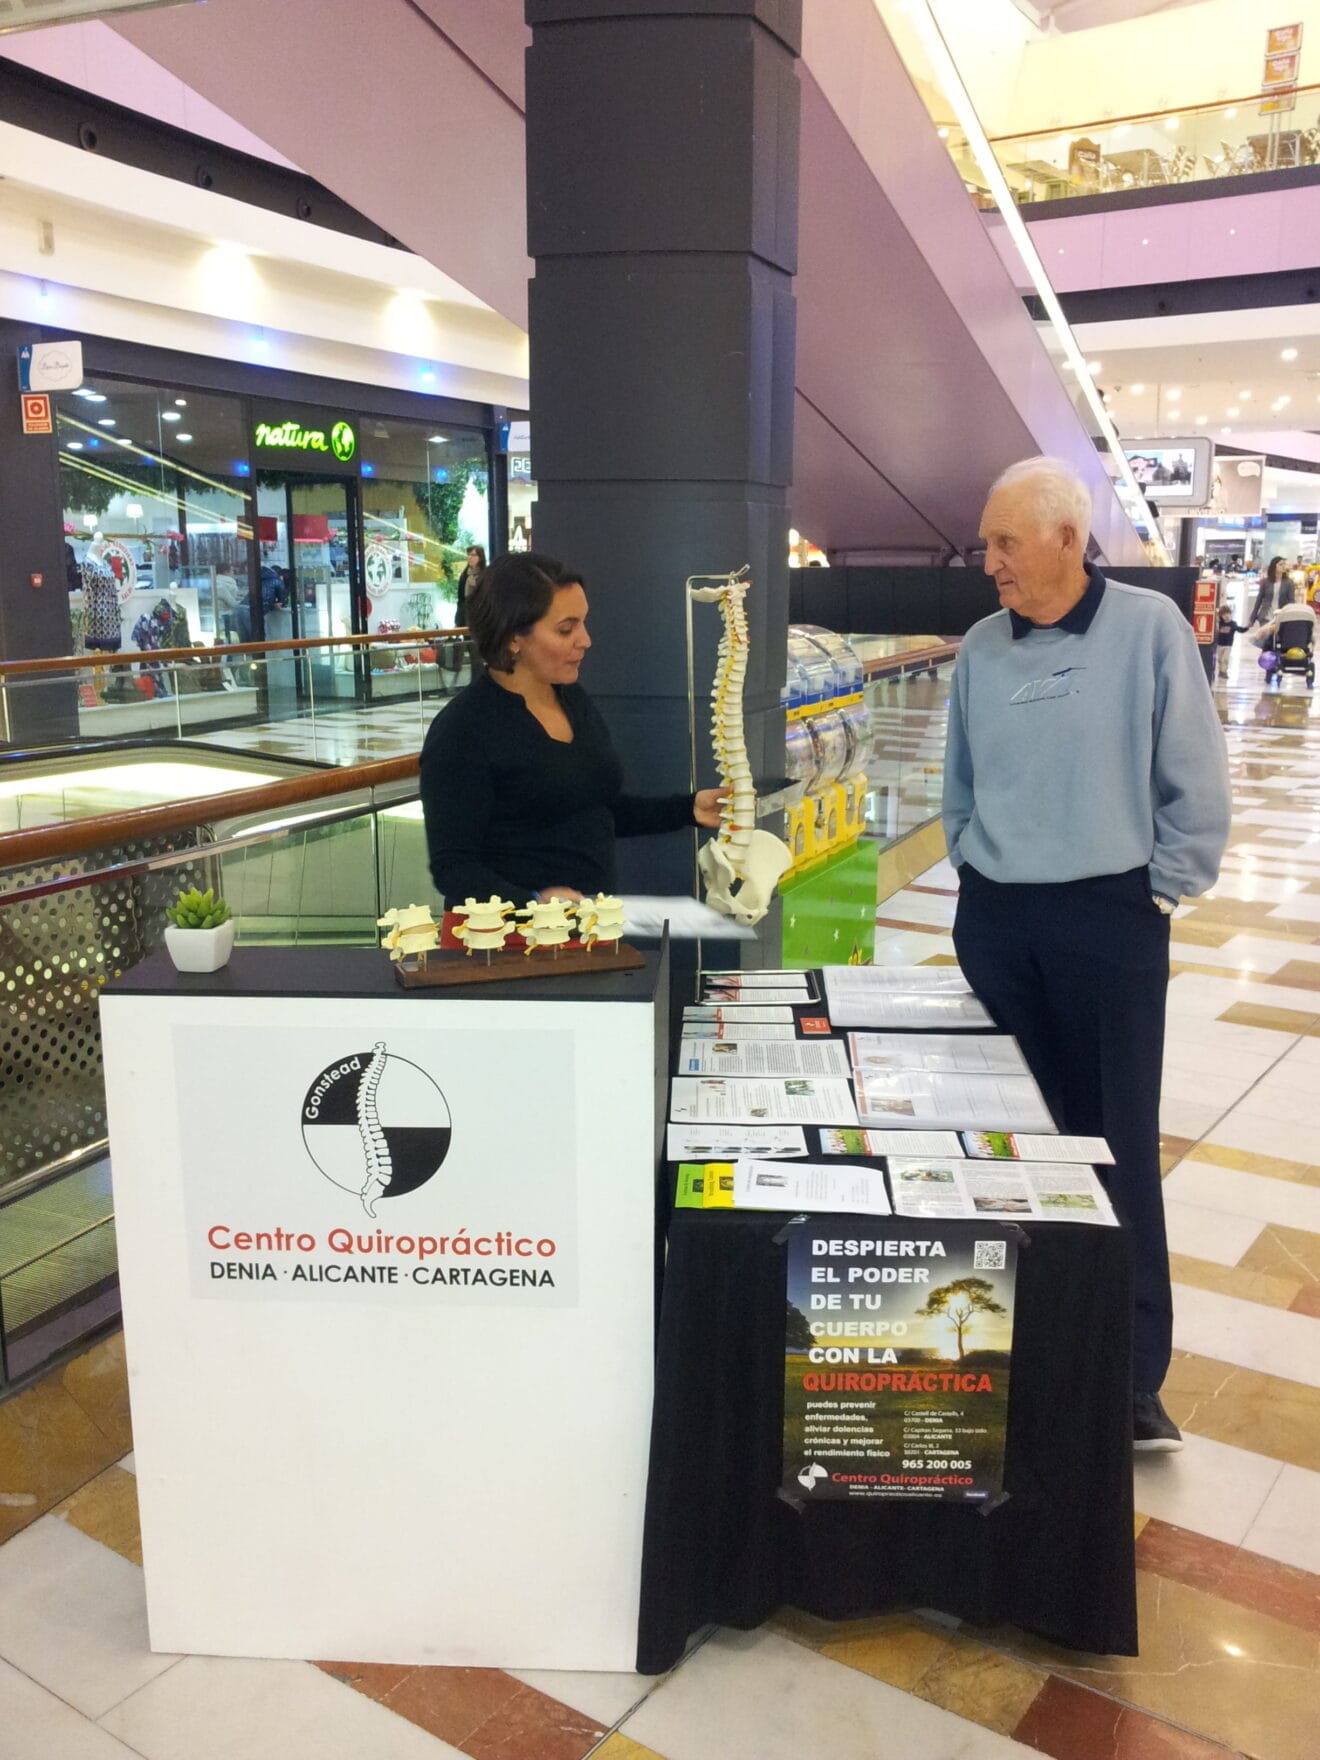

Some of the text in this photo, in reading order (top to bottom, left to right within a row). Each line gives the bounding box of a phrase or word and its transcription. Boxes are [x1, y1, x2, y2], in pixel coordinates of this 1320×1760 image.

[256, 422, 329, 451] natura
[305, 1056, 361, 1119] Gonstead
[207, 1226, 556, 1259] Centro Quiropráctico
[812, 1240, 946, 1256] DESPIERTA
[210, 1262, 555, 1287] DENIA ALICANTE CARTAGENA
[811, 1268, 930, 1283] EL PODER
[811, 1294, 881, 1310] DE TU
[810, 1321, 908, 1336] CUERPO
[809, 1348, 898, 1364] CON LA
[802, 1370, 992, 1392] QUIROPRÁCTICA
[807, 1401, 876, 1409] puedes prevenir
[805, 1413, 868, 1422] enfermedades,
[851, 1438, 883, 1446] mejorar
[902, 1460, 972, 1470] 965 200 005
[832, 1473, 973, 1485] Centro Quiropráctico
